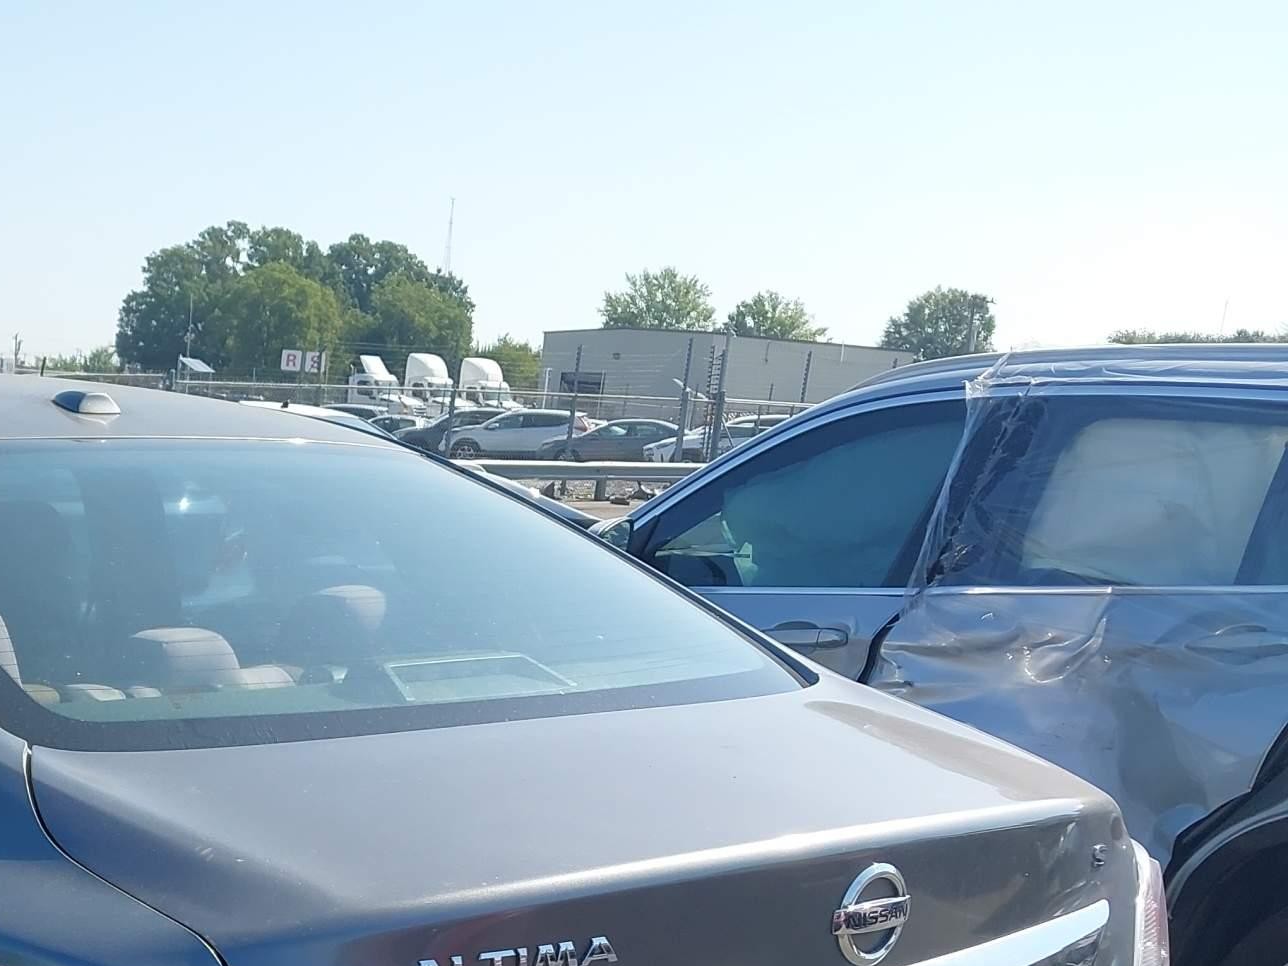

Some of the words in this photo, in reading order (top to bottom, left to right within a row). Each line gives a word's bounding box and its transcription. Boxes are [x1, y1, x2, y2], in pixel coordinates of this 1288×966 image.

[286, 353, 296, 367] R
[1091, 844, 1107, 869] S
[848, 903, 906, 928] NISSAN
